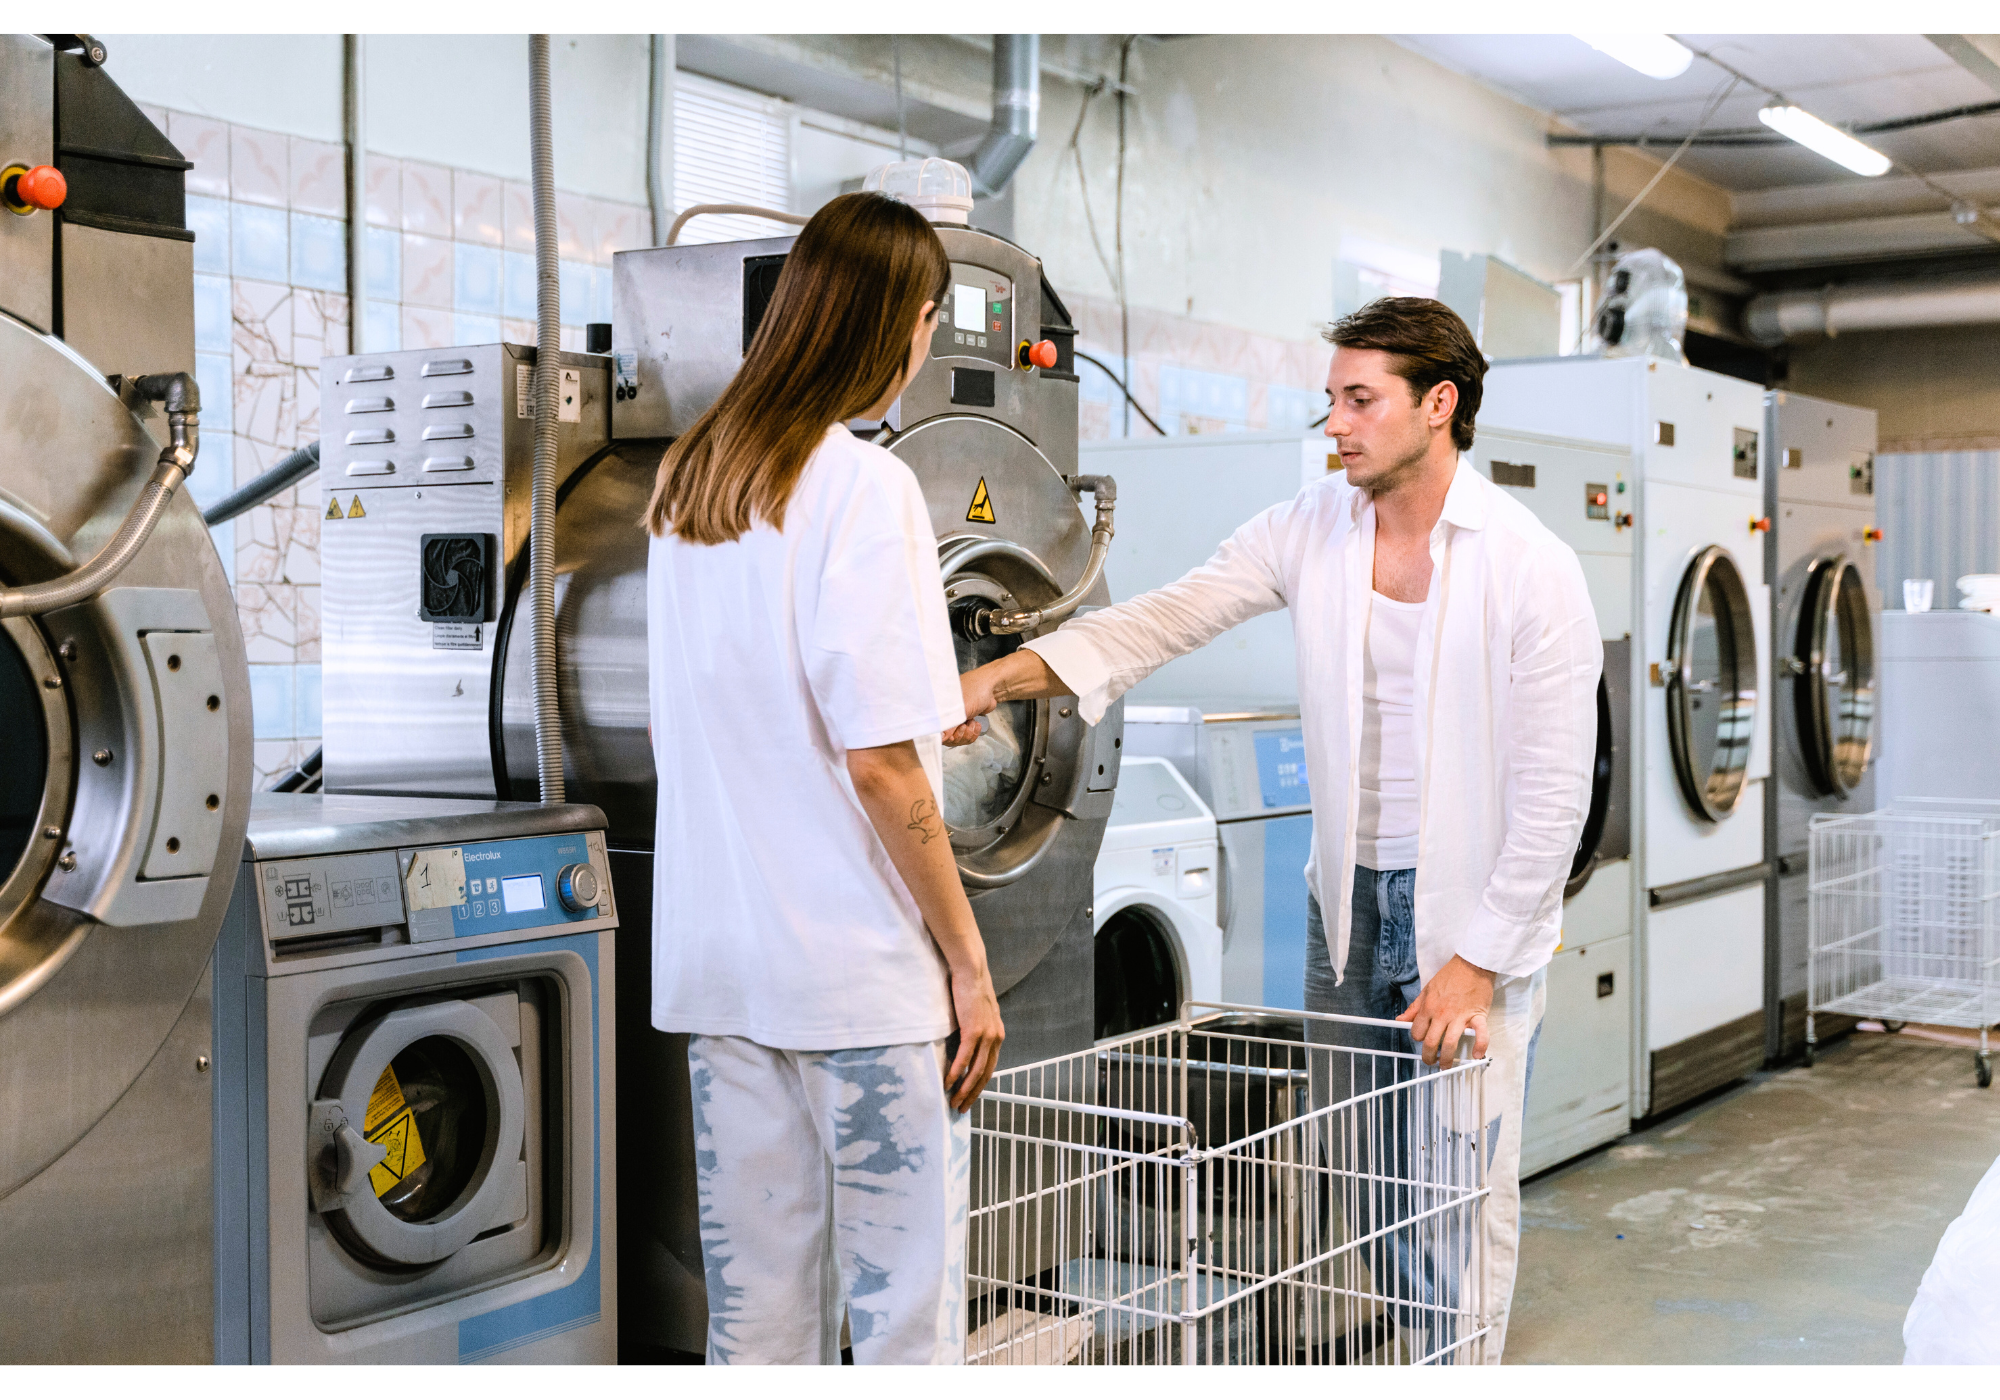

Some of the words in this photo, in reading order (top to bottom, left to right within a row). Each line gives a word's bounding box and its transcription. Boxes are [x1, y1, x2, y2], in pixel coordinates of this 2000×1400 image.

[464, 851, 501, 862] Electrolux
[420, 863, 432, 889] 1
[476, 905, 483, 915] 2
[491, 902, 498, 913] 3
